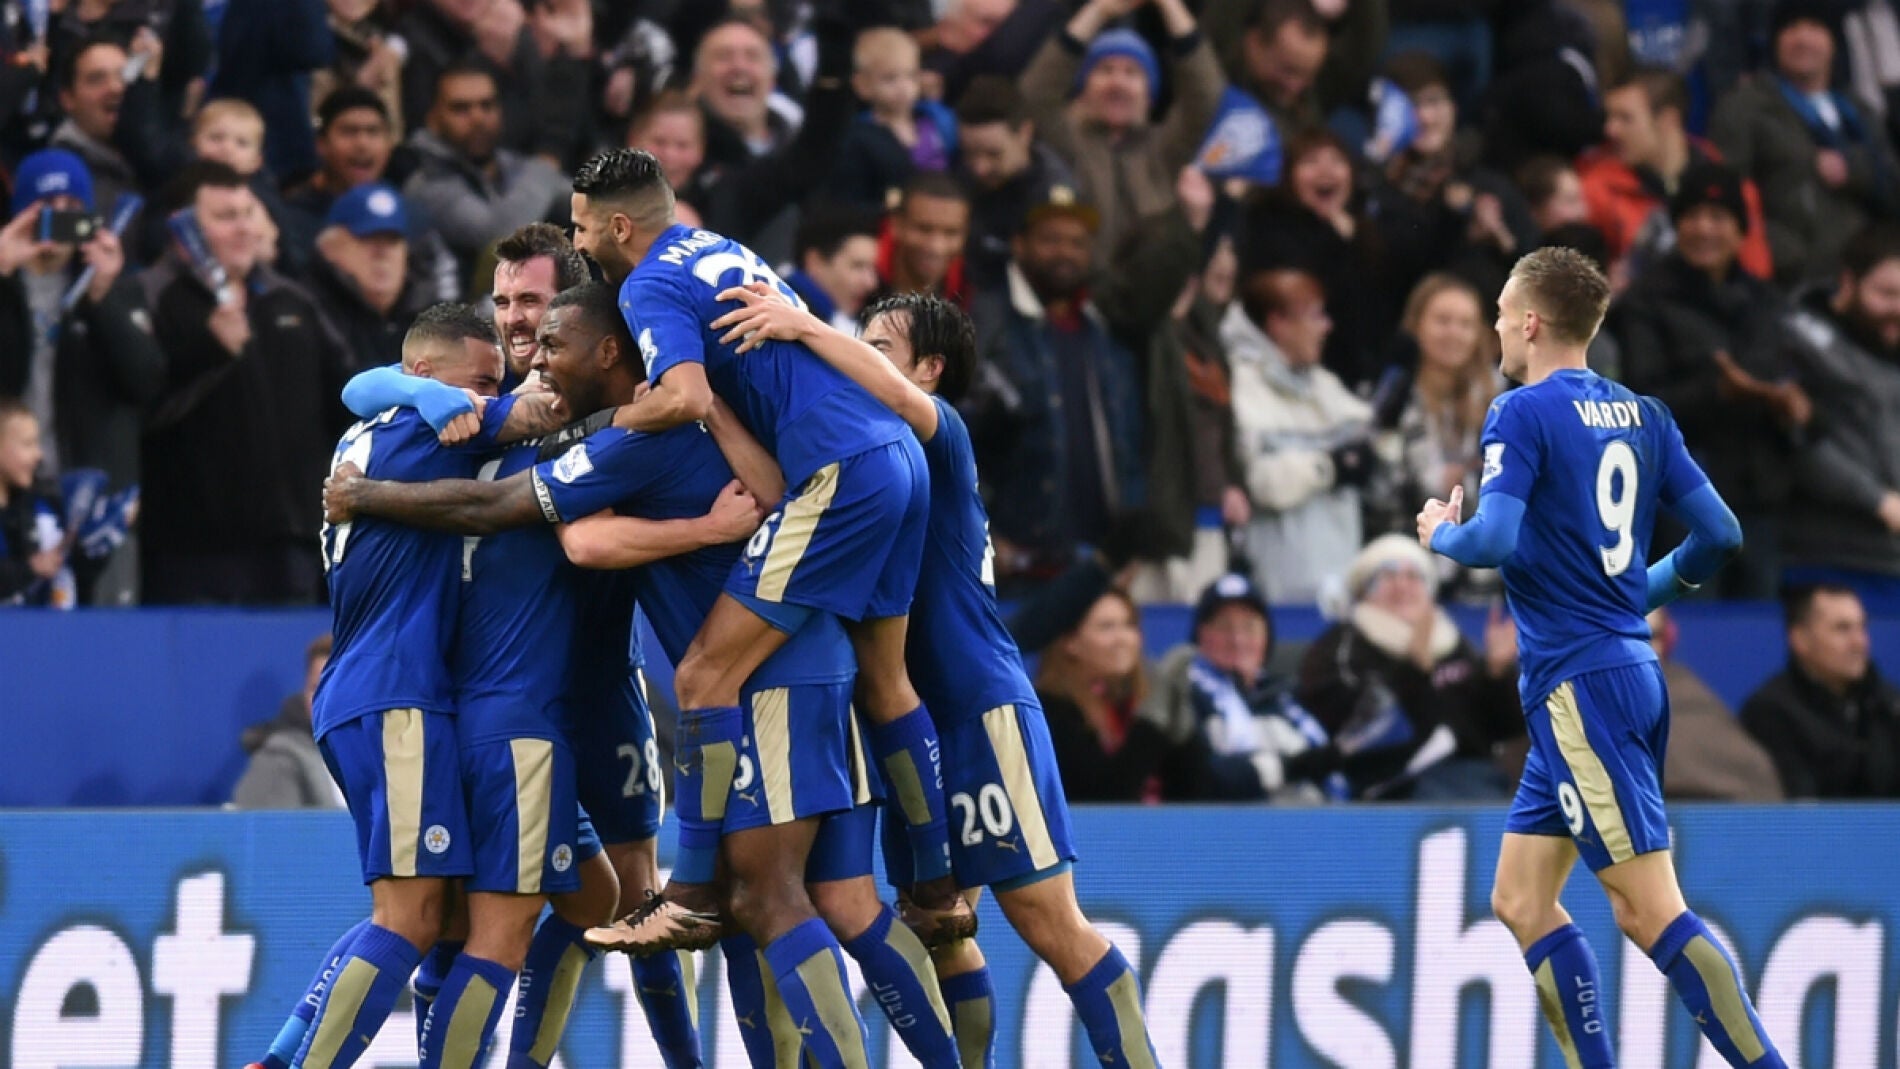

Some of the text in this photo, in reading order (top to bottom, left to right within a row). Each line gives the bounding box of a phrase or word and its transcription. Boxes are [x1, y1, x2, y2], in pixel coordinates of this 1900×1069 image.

[1572, 400, 1642, 428] VARDY
[1596, 440, 1638, 577] 9
[616, 737, 660, 797] 28
[951, 783, 1013, 847] 20
[1558, 782, 1584, 836] 9
[1574, 975, 1604, 1034] LCFC
